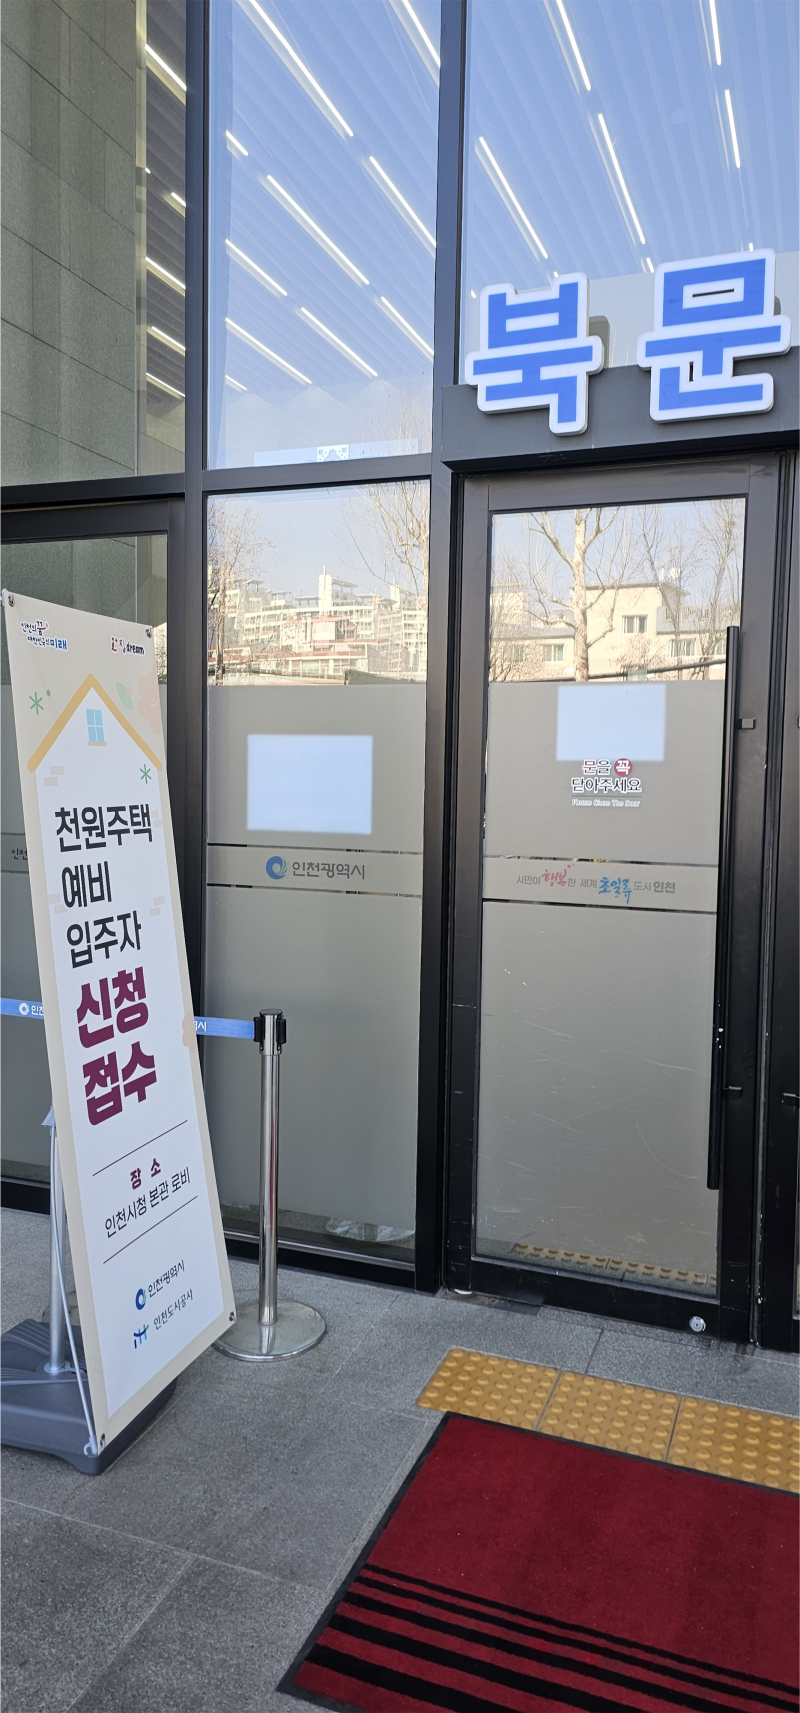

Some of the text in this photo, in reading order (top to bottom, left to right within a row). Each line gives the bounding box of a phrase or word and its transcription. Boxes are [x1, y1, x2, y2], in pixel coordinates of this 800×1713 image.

[465, 249, 791, 434] 북문
[571, 777, 642, 793] 닫아주세요
[582, 759, 632, 776] 문을 꼭
[55, 804, 153, 852] 천원주택
[62, 861, 112, 908] 예비
[292, 861, 365, 880] 인천광역시
[516, 875, 541, 885] 시민이
[580, 878, 597, 889] 세계
[598, 876, 633, 904] 초일류
[633, 881, 651, 892] 도시
[653, 881, 676, 893] 인천
[66, 910, 142, 969] 입주자
[76, 966, 149, 1048] 신청
[82, 1041, 157, 1126] 접수
[104, 1167, 191, 1238] 인천시청 본관 로비
[148, 1259, 185, 1298] 인천광역시
[153, 1288, 193, 1330] 인천도시공사
